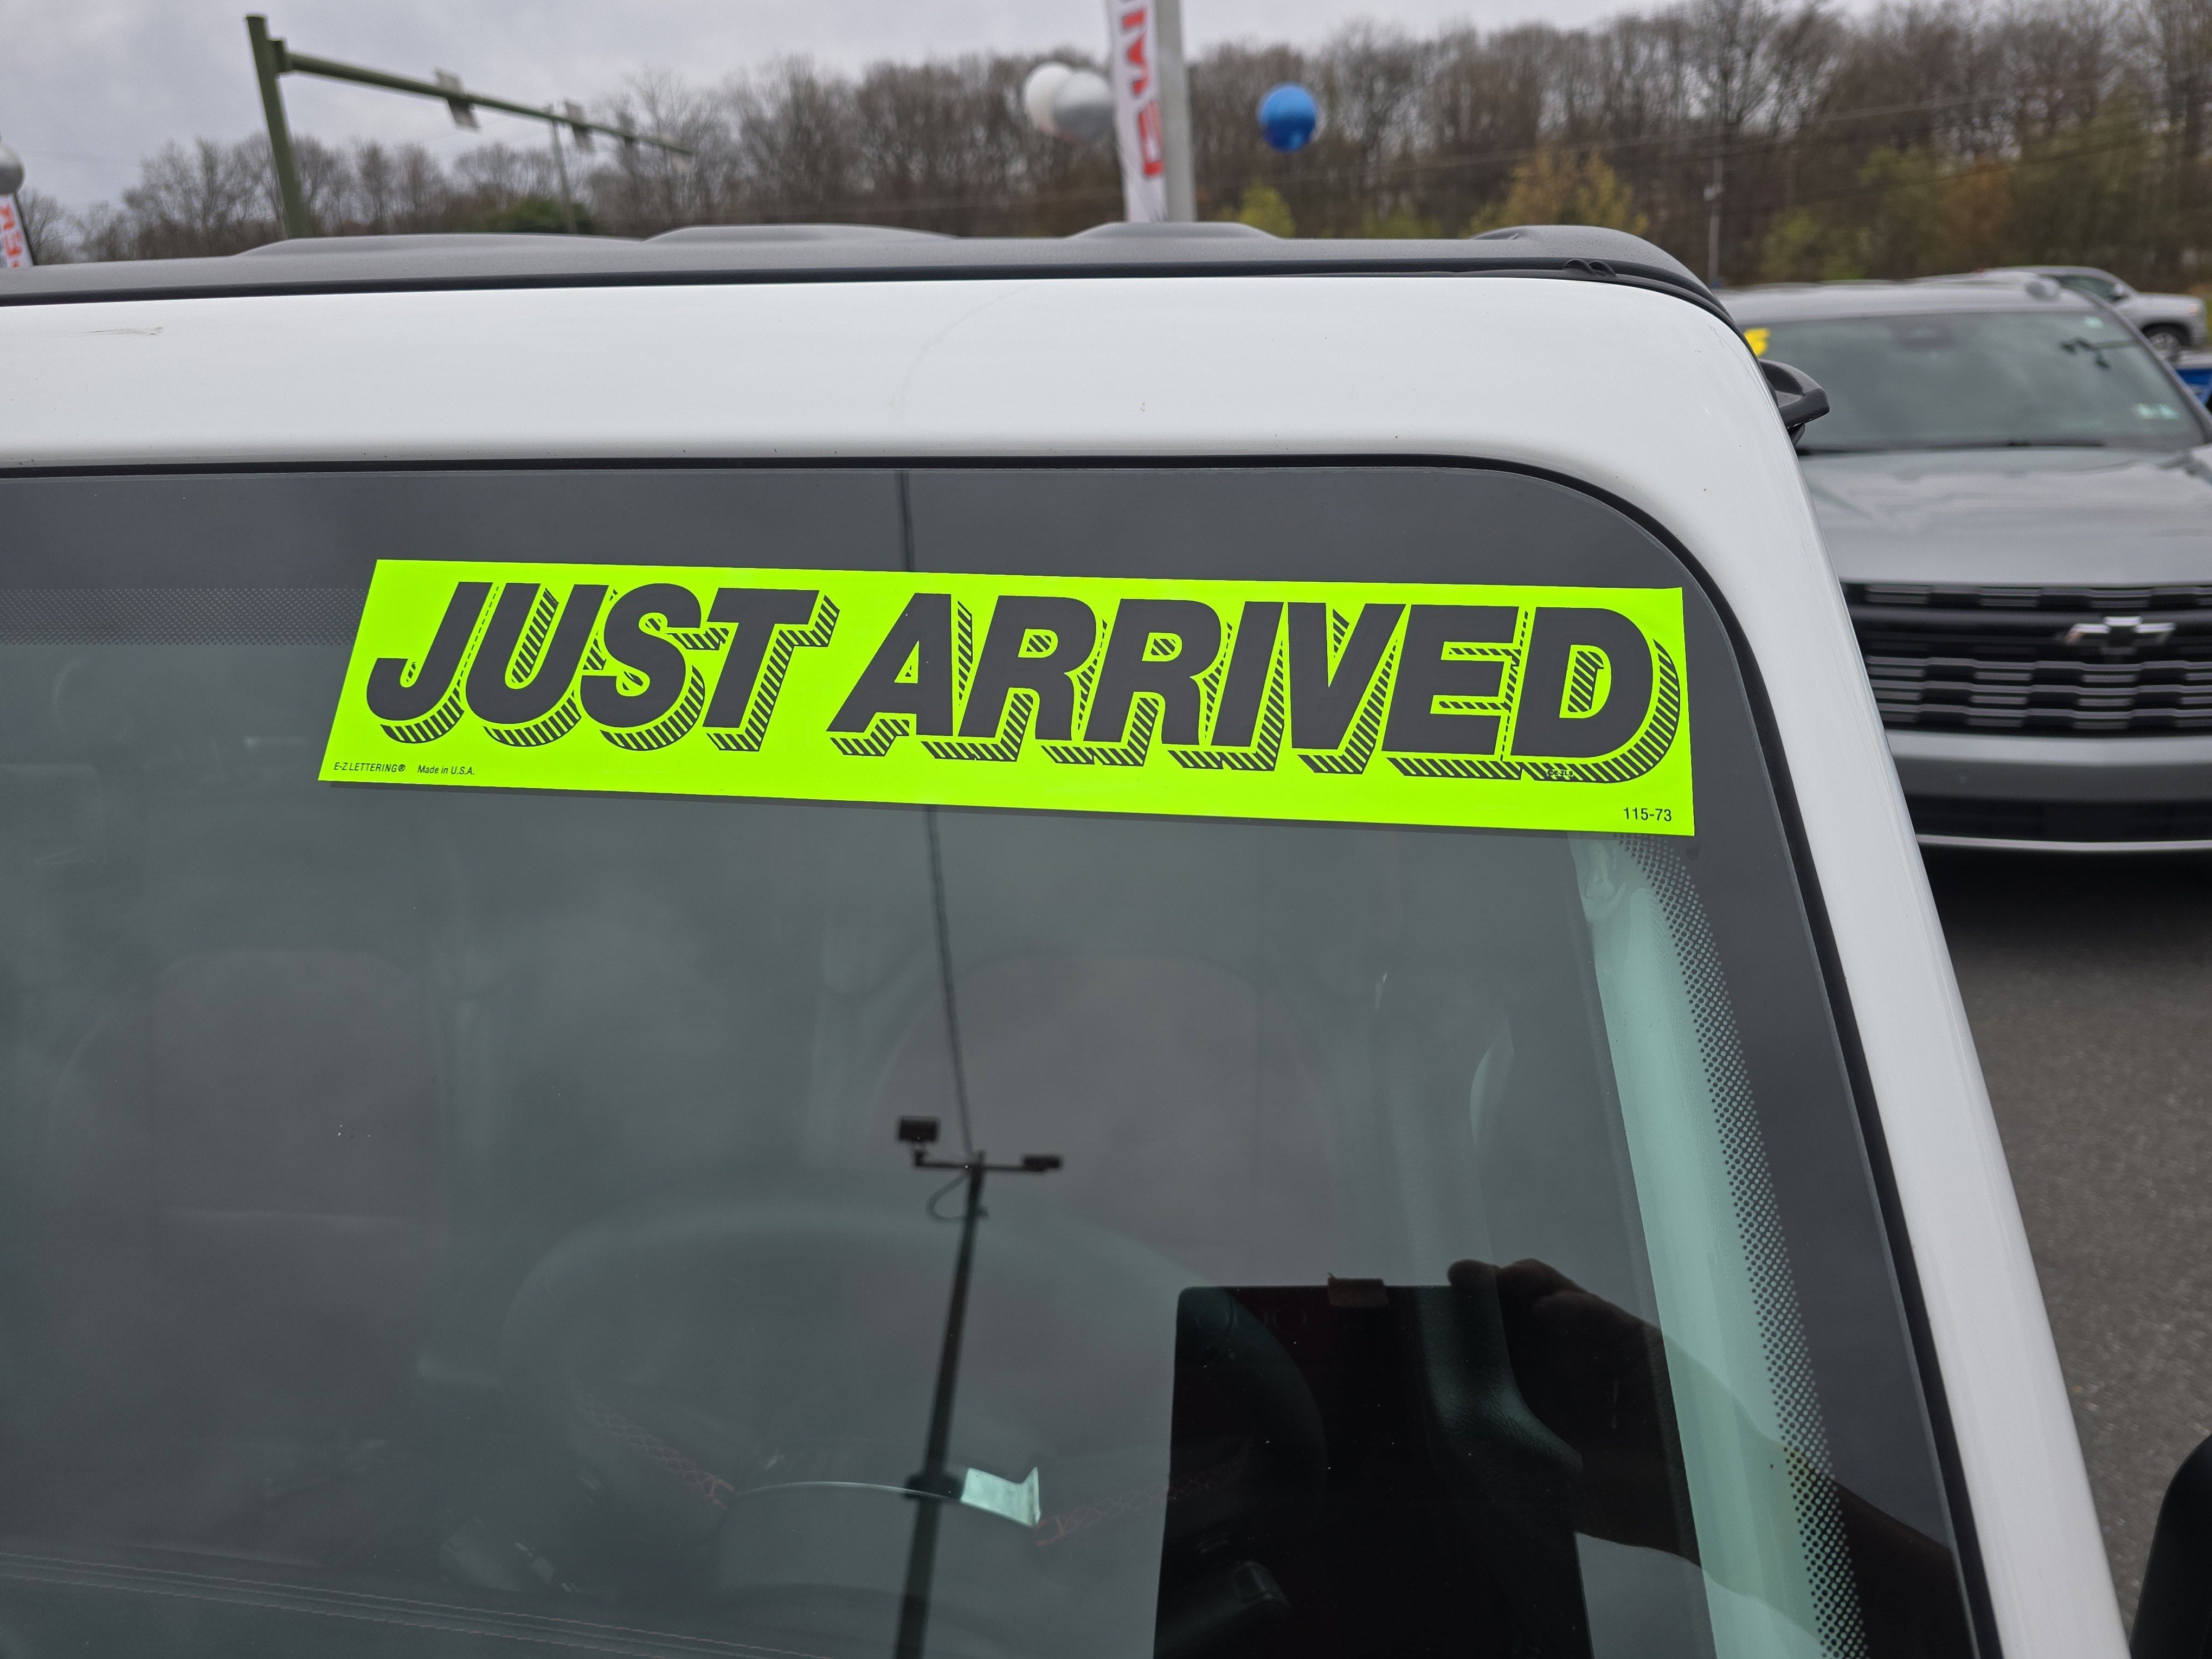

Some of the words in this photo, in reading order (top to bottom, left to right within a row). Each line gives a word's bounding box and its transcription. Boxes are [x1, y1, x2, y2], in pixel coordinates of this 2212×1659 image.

[366, 582, 840, 751] JUST
[826, 593, 1680, 783] ARRIVED
[333, 762, 348, 770] E-Z
[417, 764, 439, 774] Made
[451, 766, 475, 775] U.S.A.
[1623, 806, 1672, 822] 115-73
